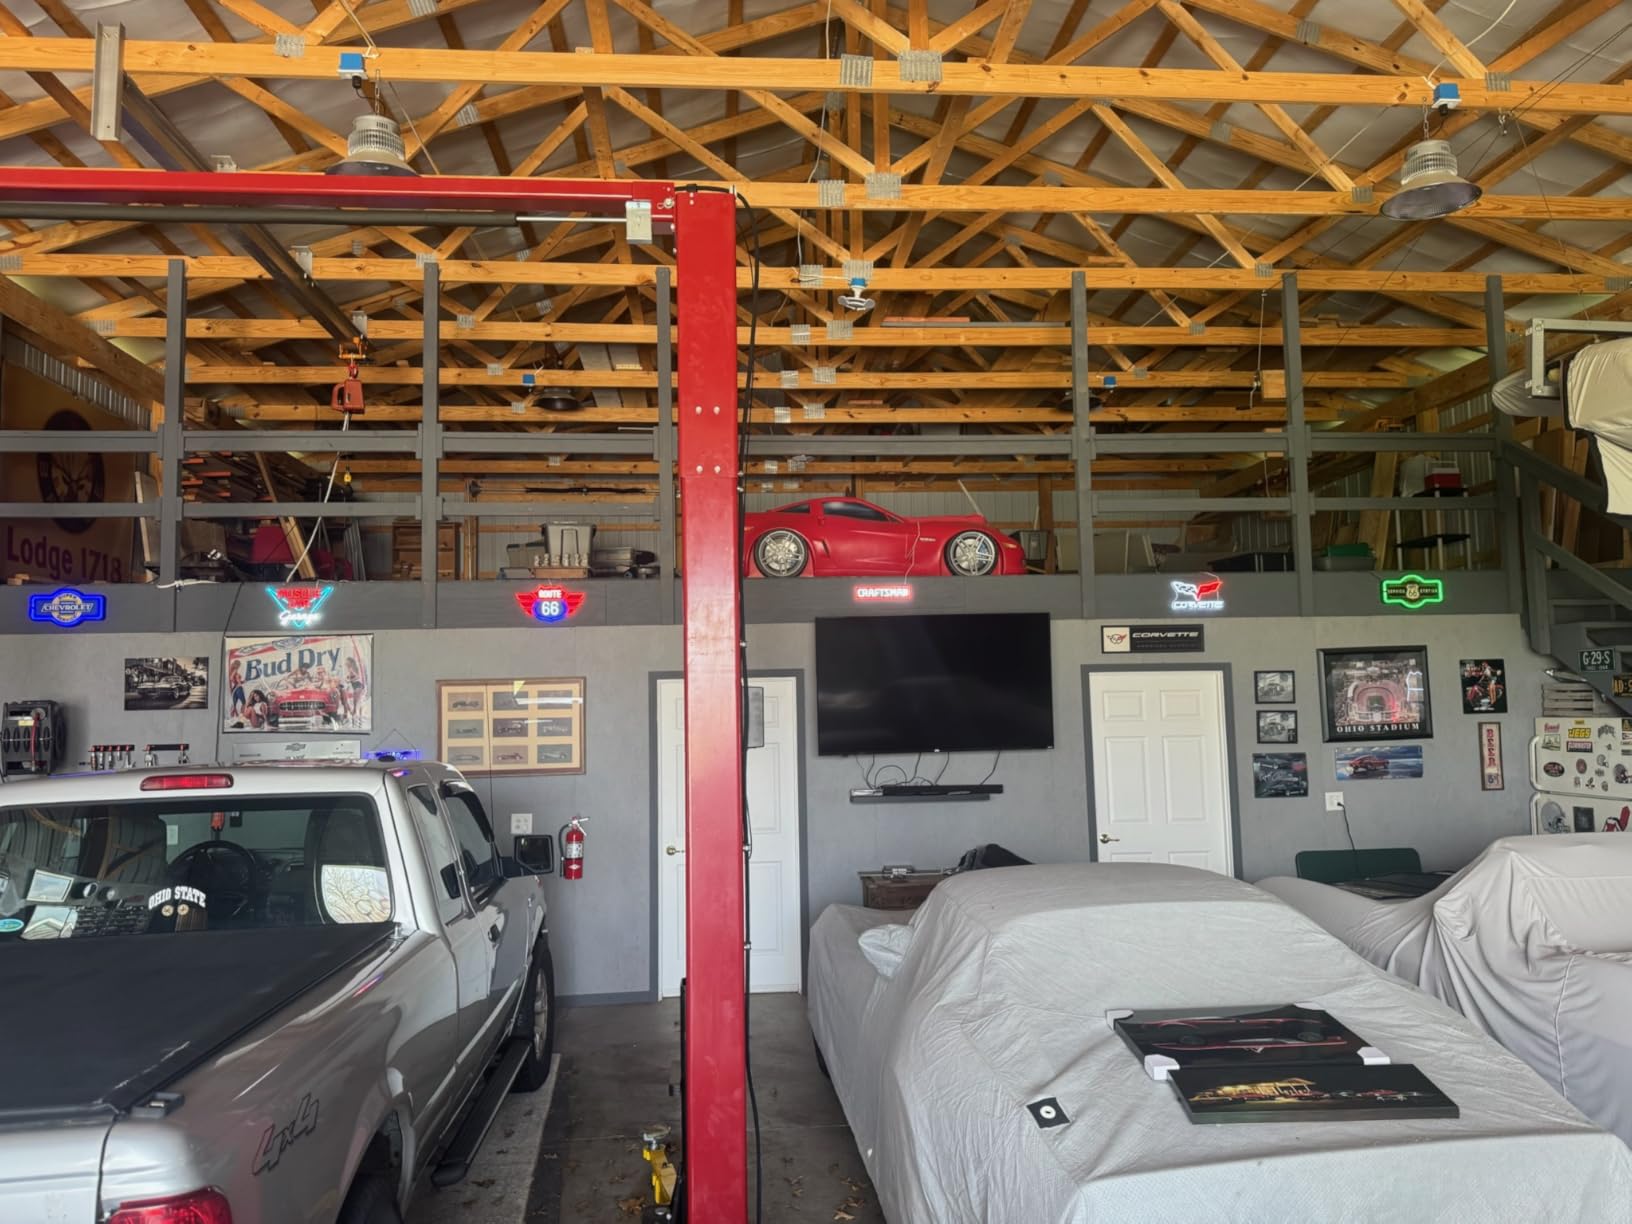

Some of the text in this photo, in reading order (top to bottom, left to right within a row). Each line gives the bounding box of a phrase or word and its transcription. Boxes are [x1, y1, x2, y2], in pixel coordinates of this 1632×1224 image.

[7, 525, 122, 583] Lodge 1718
[538, 589, 562, 599] ROUTE
[41, 603, 94, 612] CHEVROLET
[541, 600, 560, 616] 66
[1171, 600, 1225, 610] CORVETTE
[245, 647, 341, 682] Bud Dry
[1336, 722, 1420, 733] OHIO STADIUM
[148, 885, 207, 910] OHIO STATE
